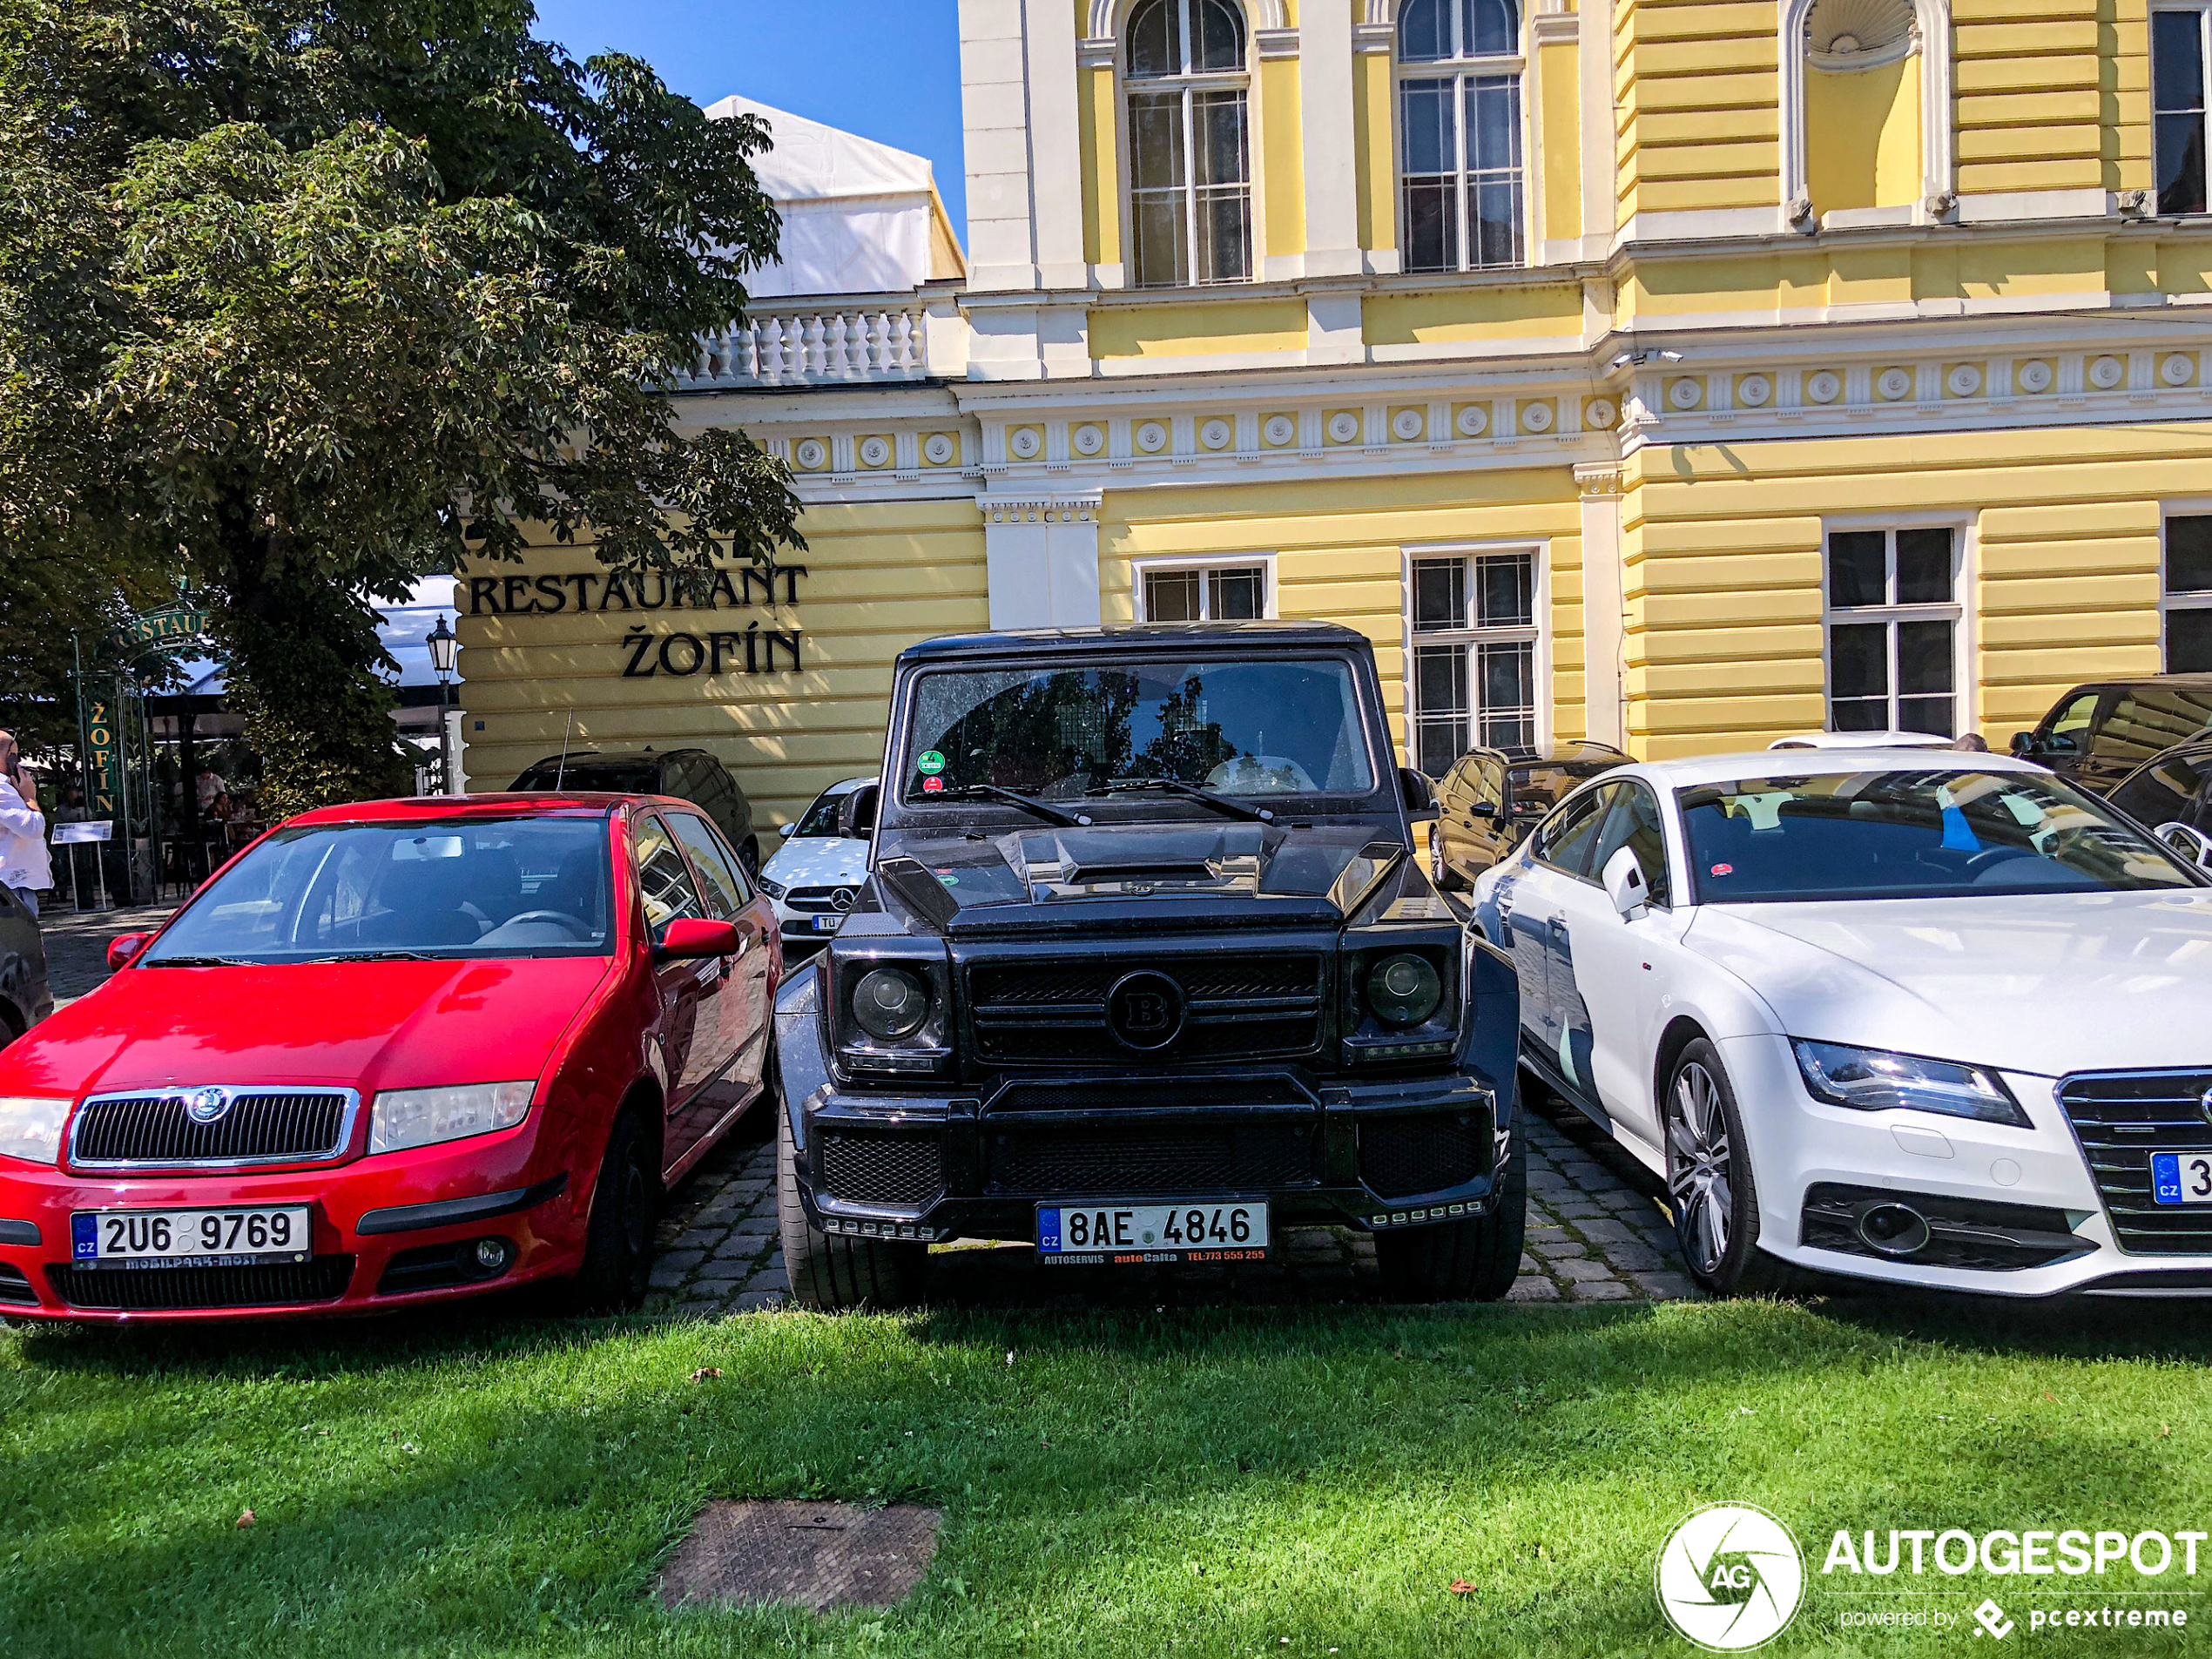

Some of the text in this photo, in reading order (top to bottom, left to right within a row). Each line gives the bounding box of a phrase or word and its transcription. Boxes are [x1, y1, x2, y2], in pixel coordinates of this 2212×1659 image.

[622, 620, 804, 678] ŽOFÍN
[91, 702, 115, 813] ŽOFÍN
[2160, 1185, 2179, 1197] CZ
[2189, 1159, 2212, 1196] 3
[105, 1212, 291, 1253] 2U6 9769
[1042, 1236, 1059, 1247] CZ
[1069, 1208, 1251, 1246] 8AE 4846
[78, 1242, 95, 1253] CZ
[1044, 1254, 1104, 1264] AUTOSERVIS
[1224, 1251, 1244, 1260] 555
